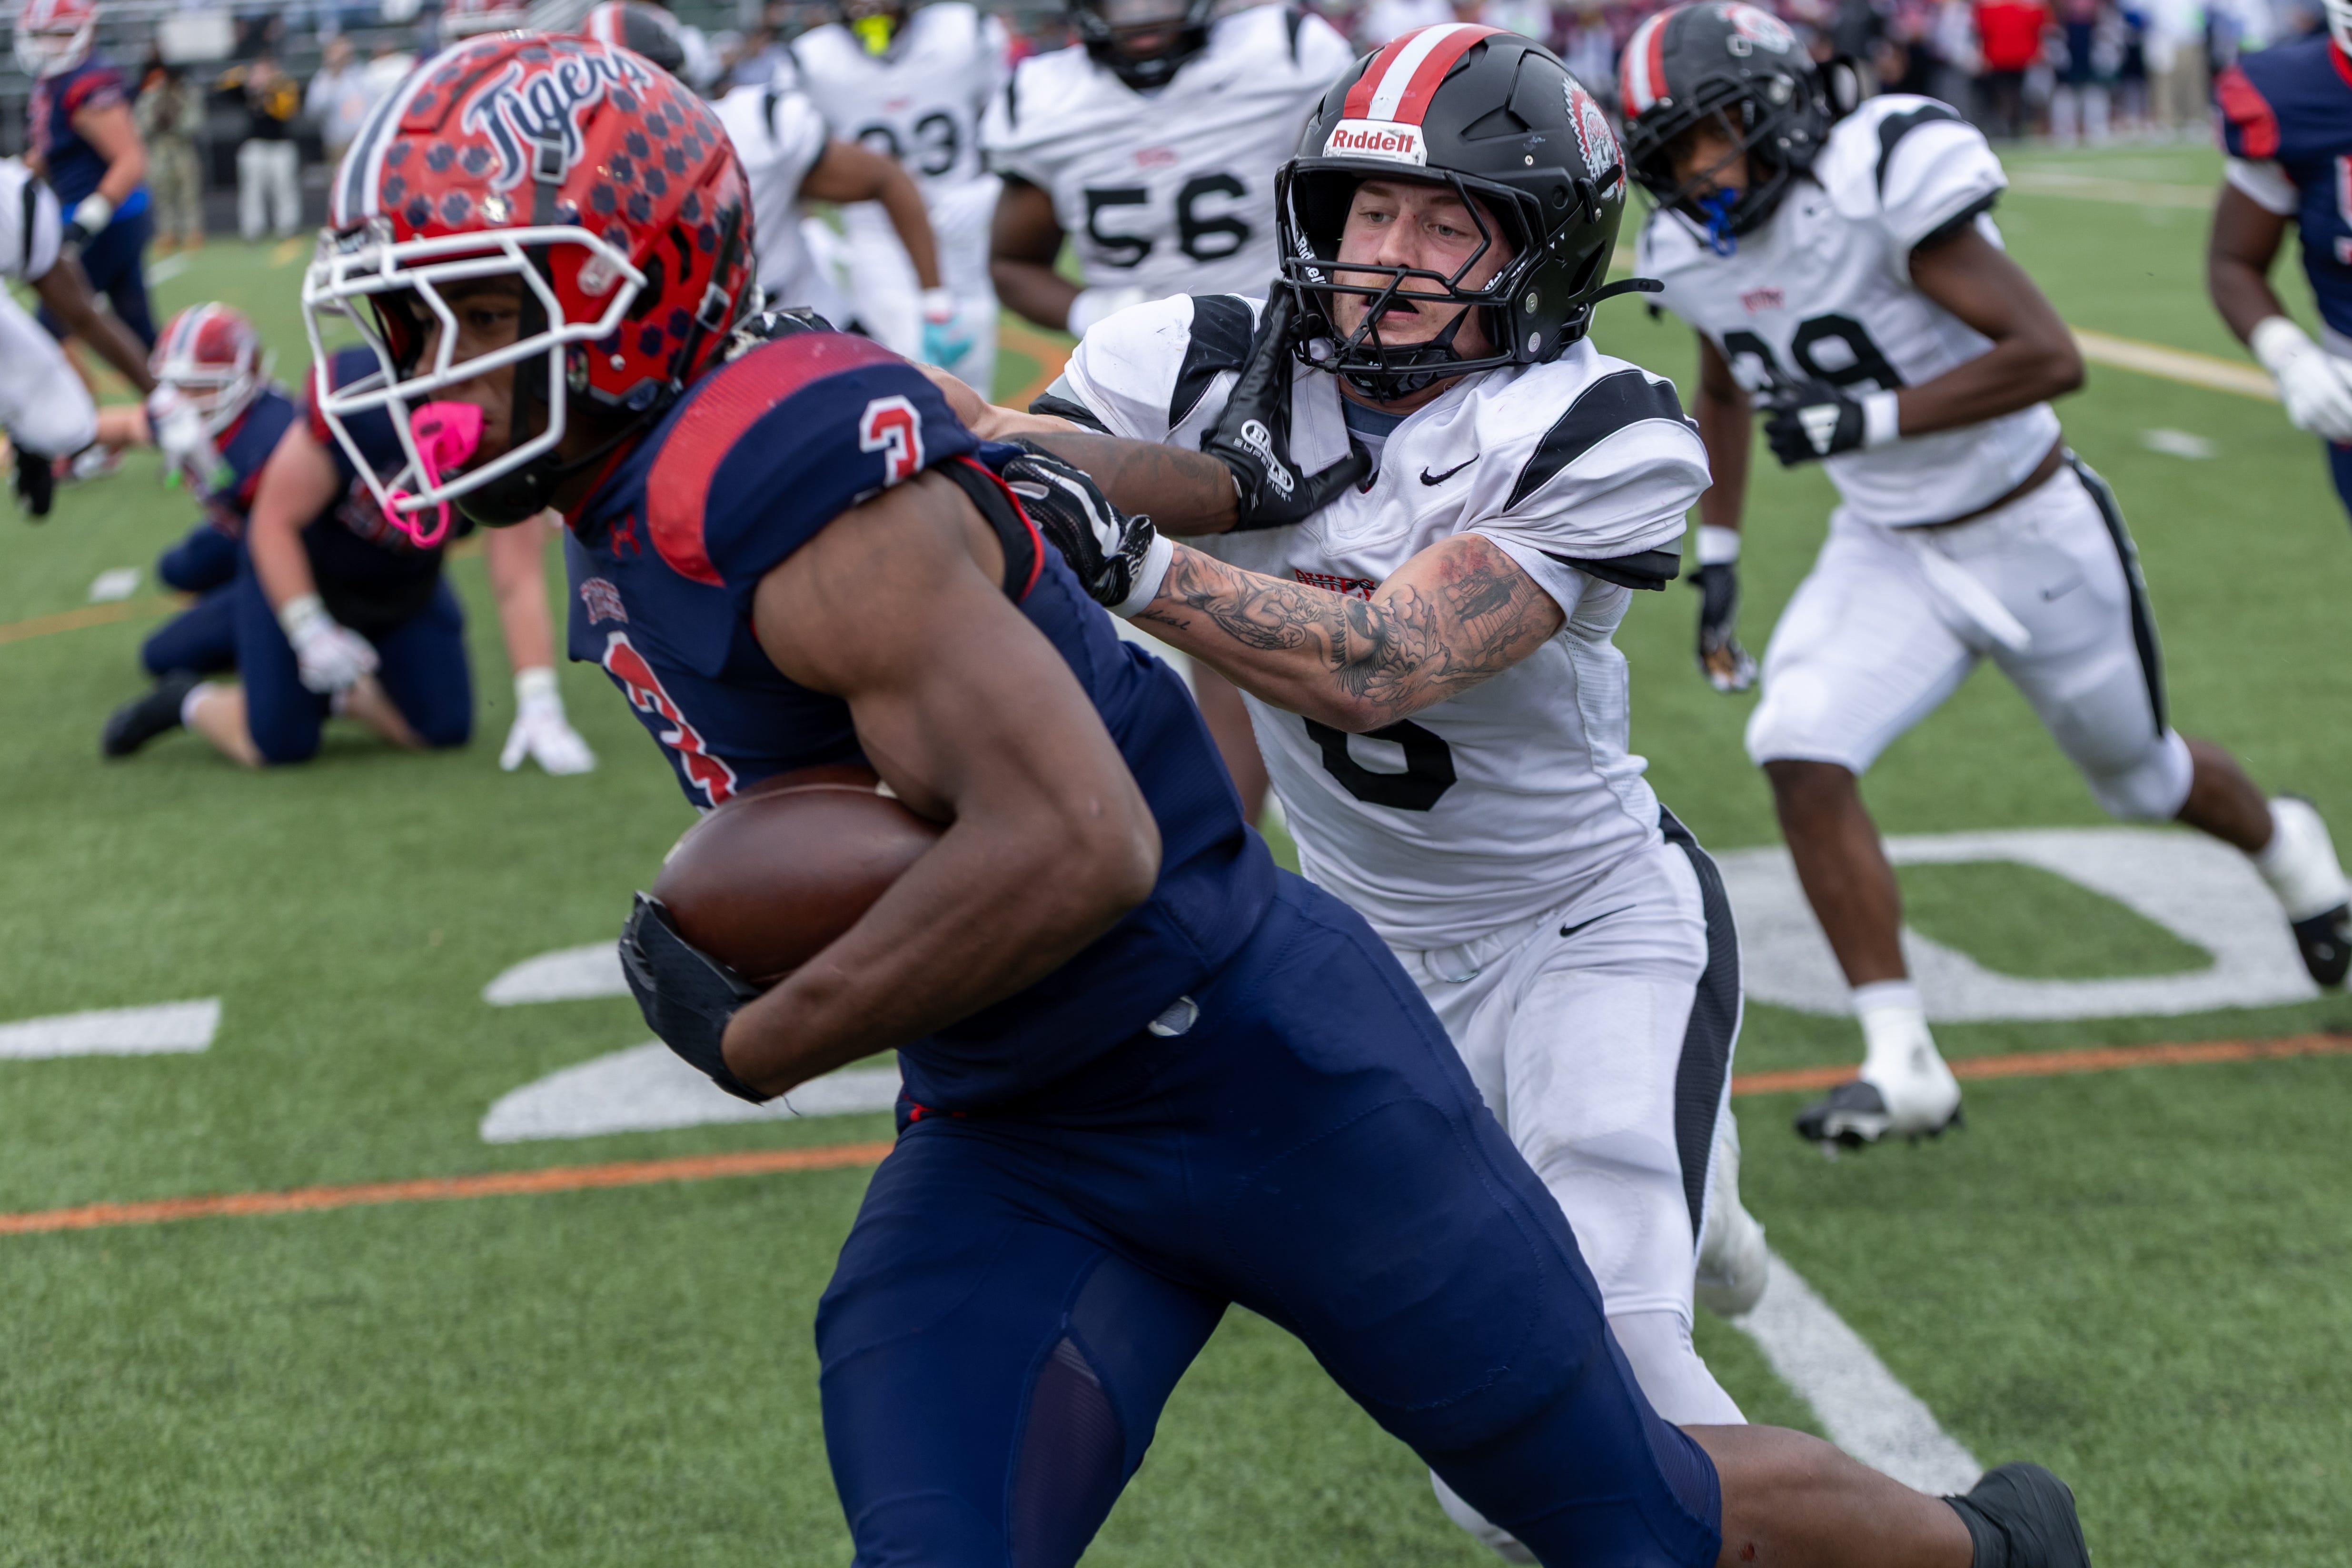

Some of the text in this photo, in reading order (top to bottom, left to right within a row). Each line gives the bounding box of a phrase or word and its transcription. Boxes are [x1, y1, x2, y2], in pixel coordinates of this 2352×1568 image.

[461, 45, 654, 191] Tigers
[1332, 129, 1414, 153] Riddell
[1085, 173, 1250, 267] 56
[1297, 236, 1327, 283] Ridel
